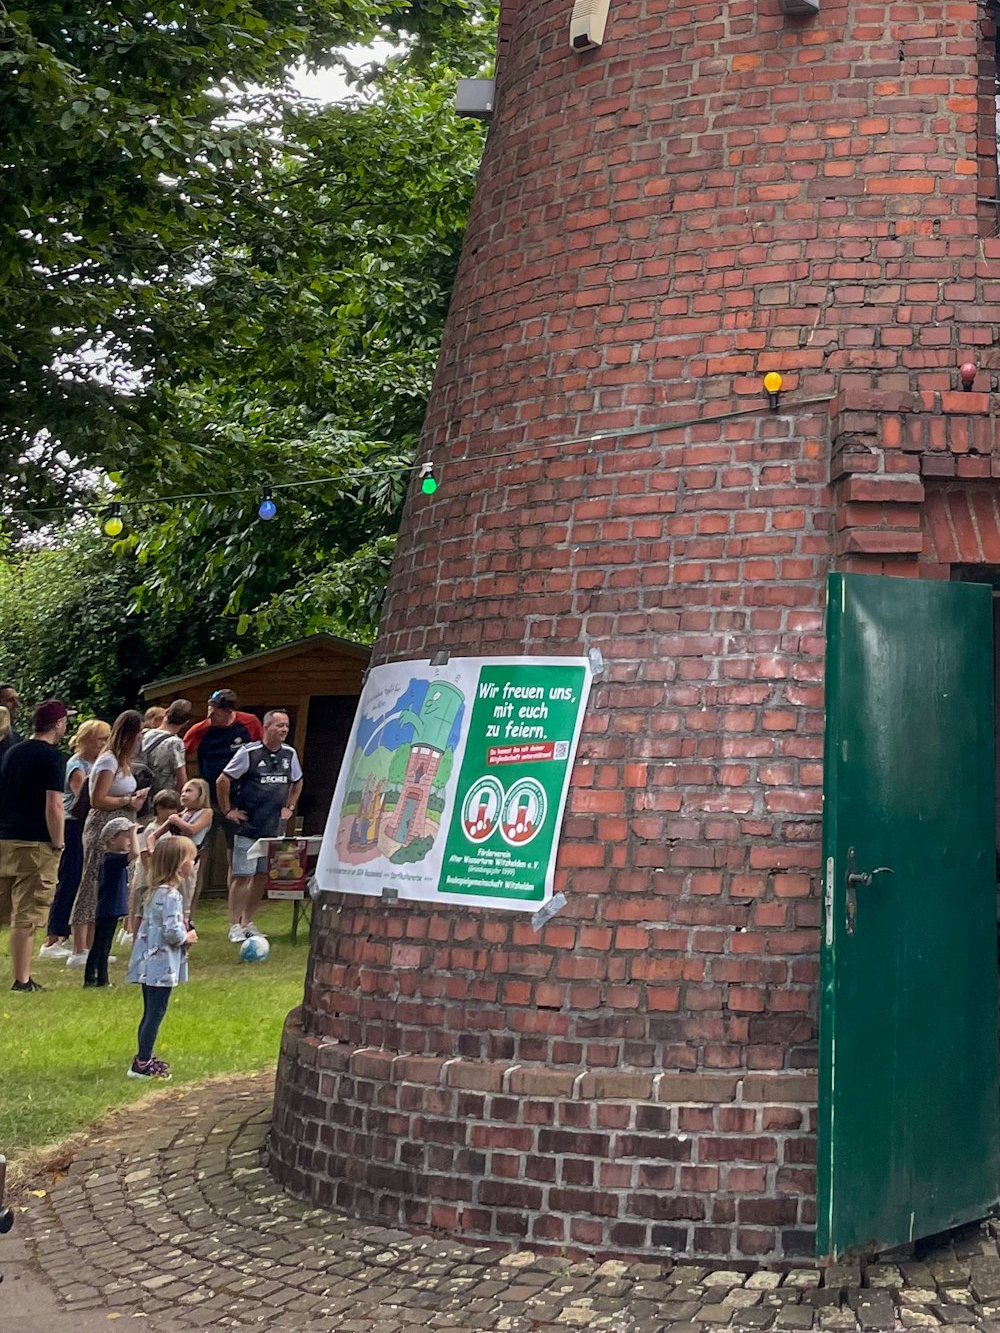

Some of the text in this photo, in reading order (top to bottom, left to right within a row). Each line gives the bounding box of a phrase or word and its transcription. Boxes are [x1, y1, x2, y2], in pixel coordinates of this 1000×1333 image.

[479, 681, 576, 703] Wir freuen uns,
[493, 701, 548, 719] mit euch
[485, 720, 548, 739] zu feiern.
[463, 855, 494, 866] Wasserturm
[495, 857, 527, 868] Witzhelden
[477, 847, 511, 858] Förderverein
